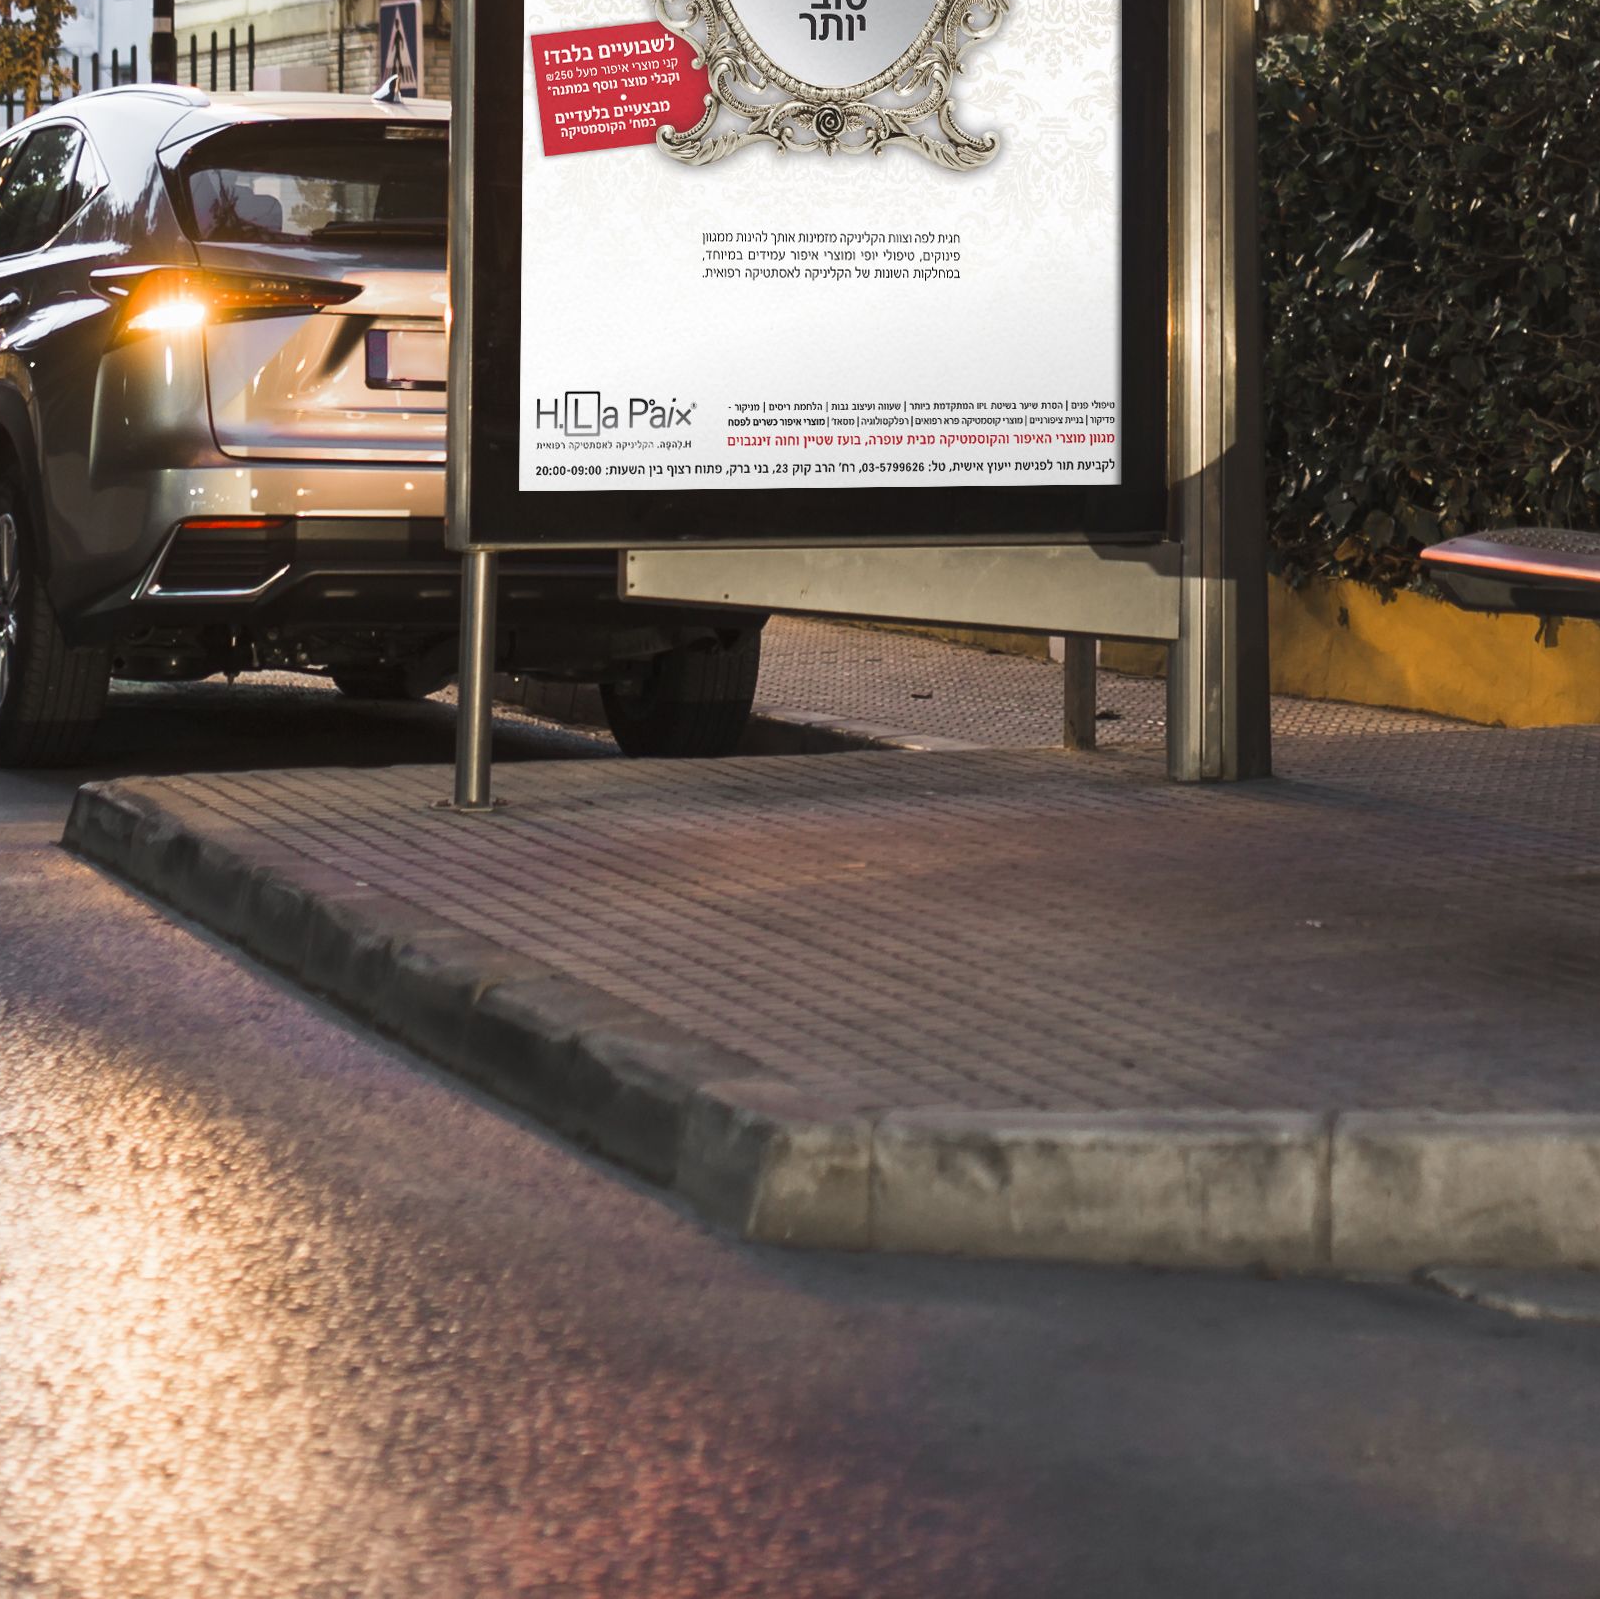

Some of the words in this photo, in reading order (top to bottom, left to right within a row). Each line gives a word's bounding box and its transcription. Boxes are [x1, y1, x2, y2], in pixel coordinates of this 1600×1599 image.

[799, 11, 866, 42] יותר
[598, 34, 675, 60] לשבועיים
[544, 45, 593, 65] בלבד!
[601, 64, 630, 77] איפור
[632, 60, 660, 73] מוצרי
[662, 57, 678, 72] קני
[576, 66, 598, 78] מעל
[624, 76, 648, 88] מוצר
[651, 71, 680, 86] וקבלי
[593, 80, 619, 94] נוסף
[555, 106, 610, 125] בלעדיים
[614, 100, 670, 119] מבצעיים
[560, 121, 627, 139] הקוסמטיקה
[702, 233, 733, 245] ממגוון
[736, 230, 768, 242] להינות
[771, 233, 796, 246] אותך
[798, 233, 838, 243] מזמינות
[840, 231, 886, 246] הקליניקה
[888, 234, 912, 243] וצוות
[915, 232, 935, 243] לפה
[938, 234, 961, 243] חגית
[748, 251, 786, 261] עמידים
[790, 251, 819, 260] איפור
[824, 251, 856, 260] ומוצרי
[861, 251, 878, 261] יופי
[883, 249, 915, 261] טיפולי
[745, 266, 801, 280] לאסתטיקה
[805, 266, 852, 281] הקליניקה
[855, 266, 871, 278] של
[874, 269, 909, 278] השונות
[913, 267, 961, 281] במחלקות
[727, 436, 772, 446] זינגבוים
[775, 436, 800, 446] וחוה
[804, 436, 834, 448] שטיין
[837, 436, 862, 446] בועז
[907, 435, 936, 445] מבית
[940, 435, 1010, 447] והקוסמטיקה
[1013, 434, 1053, 444] האיפור
[1056, 434, 1087, 443] מוצרי
[1089, 434, 1115, 447] מגוון
[695, 465, 723, 474] פתוח
[754, 464, 770, 473] בני
[793, 464, 812, 476] קוק
[815, 464, 836, 472] הרב
[987, 462, 1012, 474] ייעוץ
[1015, 459, 1054, 471] לפגישת
[1056, 461, 1075, 470] תור
[1077, 457, 1115, 472] לקביעת
[649, 465, 664, 477] בין
[667, 465, 692, 477] רצוף
